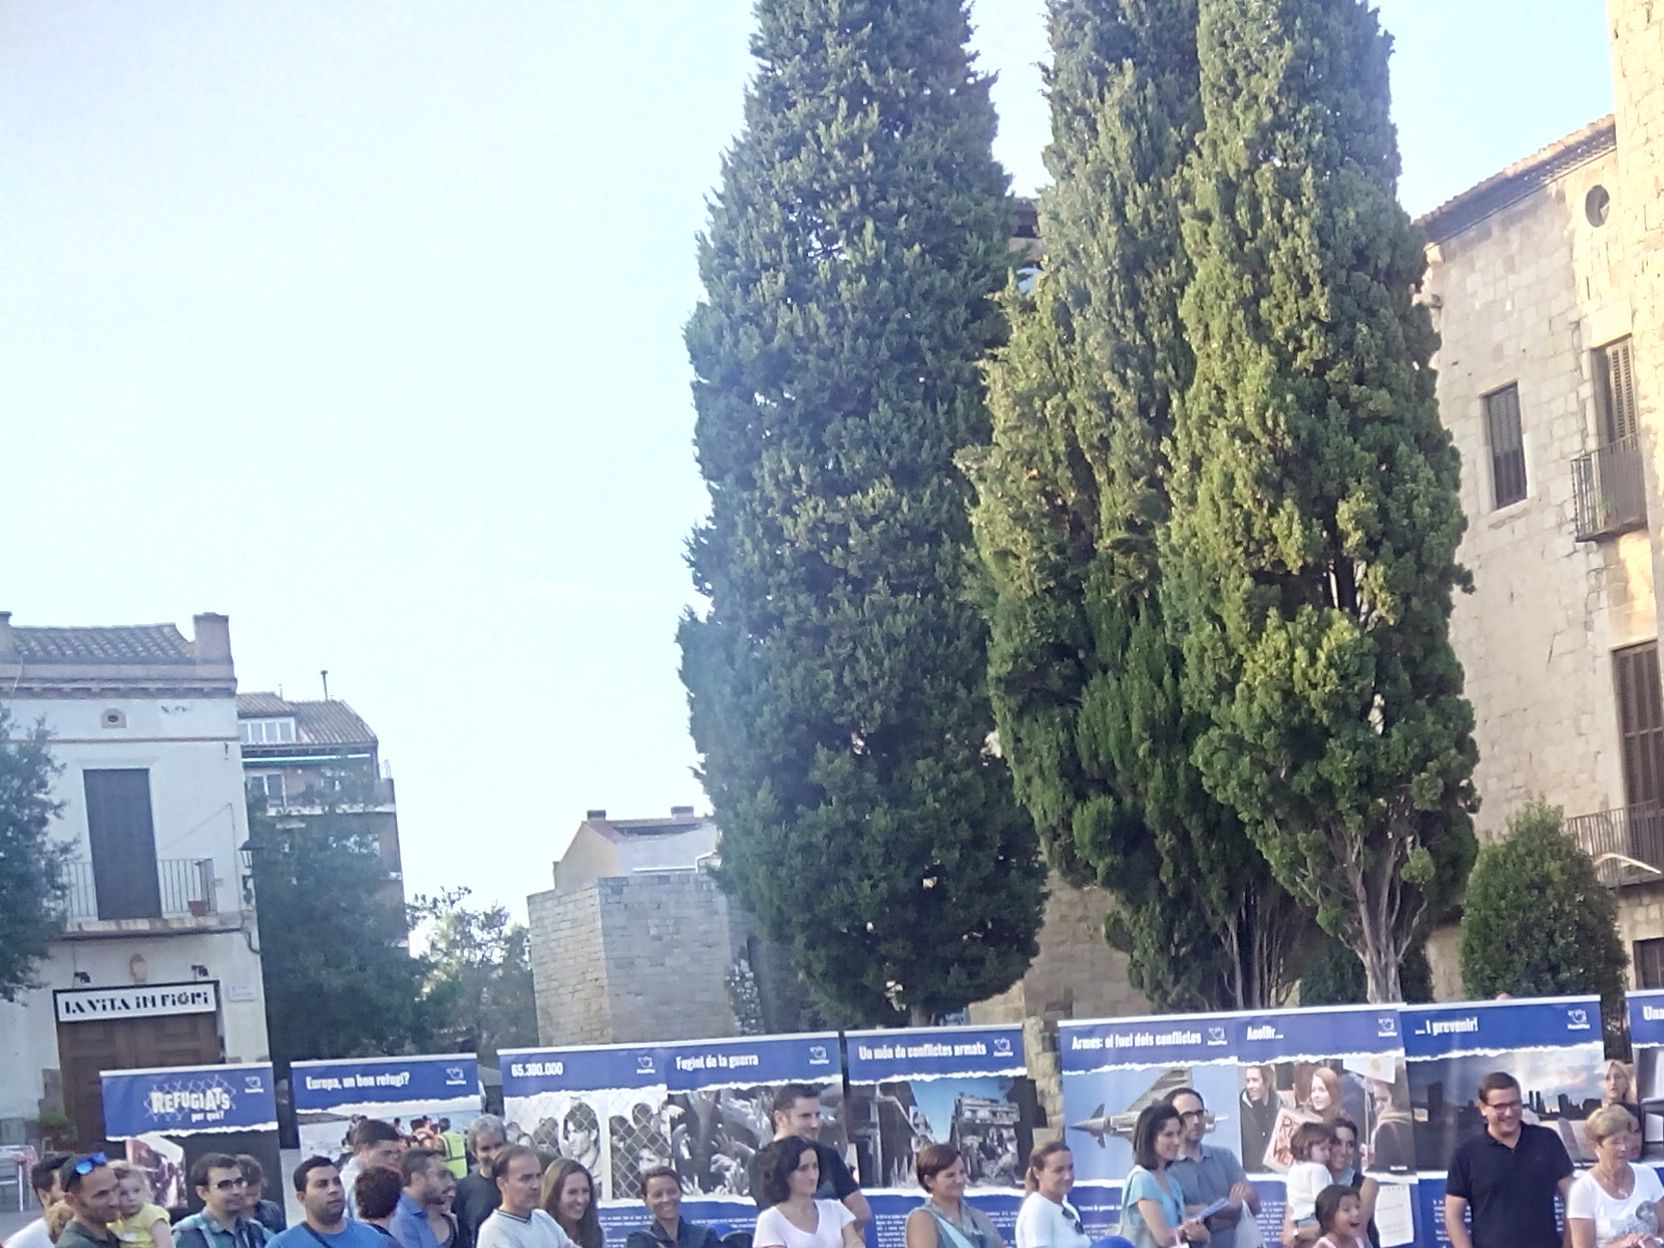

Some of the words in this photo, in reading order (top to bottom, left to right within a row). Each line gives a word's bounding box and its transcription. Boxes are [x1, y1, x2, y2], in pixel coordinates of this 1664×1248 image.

[65, 1001, 85, 1014] LA
[1072, 1035, 1103, 1050] Armes:
[1134, 1032, 1154, 1047] dels
[1155, 1030, 1201, 1046] conflictes
[858, 1045, 873, 1060] Un
[895, 1043, 906, 1059] de
[907, 1042, 953, 1058] conflictes
[954, 1041, 987, 1056] armats
[511, 1062, 564, 1077] 65.300.000
[706, 1054, 717, 1068] de
[718, 1054, 728, 1067] la
[729, 1054, 759, 1069] guerra
[306, 1076, 342, 1091] Europa,
[343, 1077, 355, 1088] un
[356, 1074, 375, 1087] bon
[376, 1071, 410, 1088] refugi?
[151, 1087, 230, 1113] REFUGIATS
[191, 1112, 205, 1122] per
